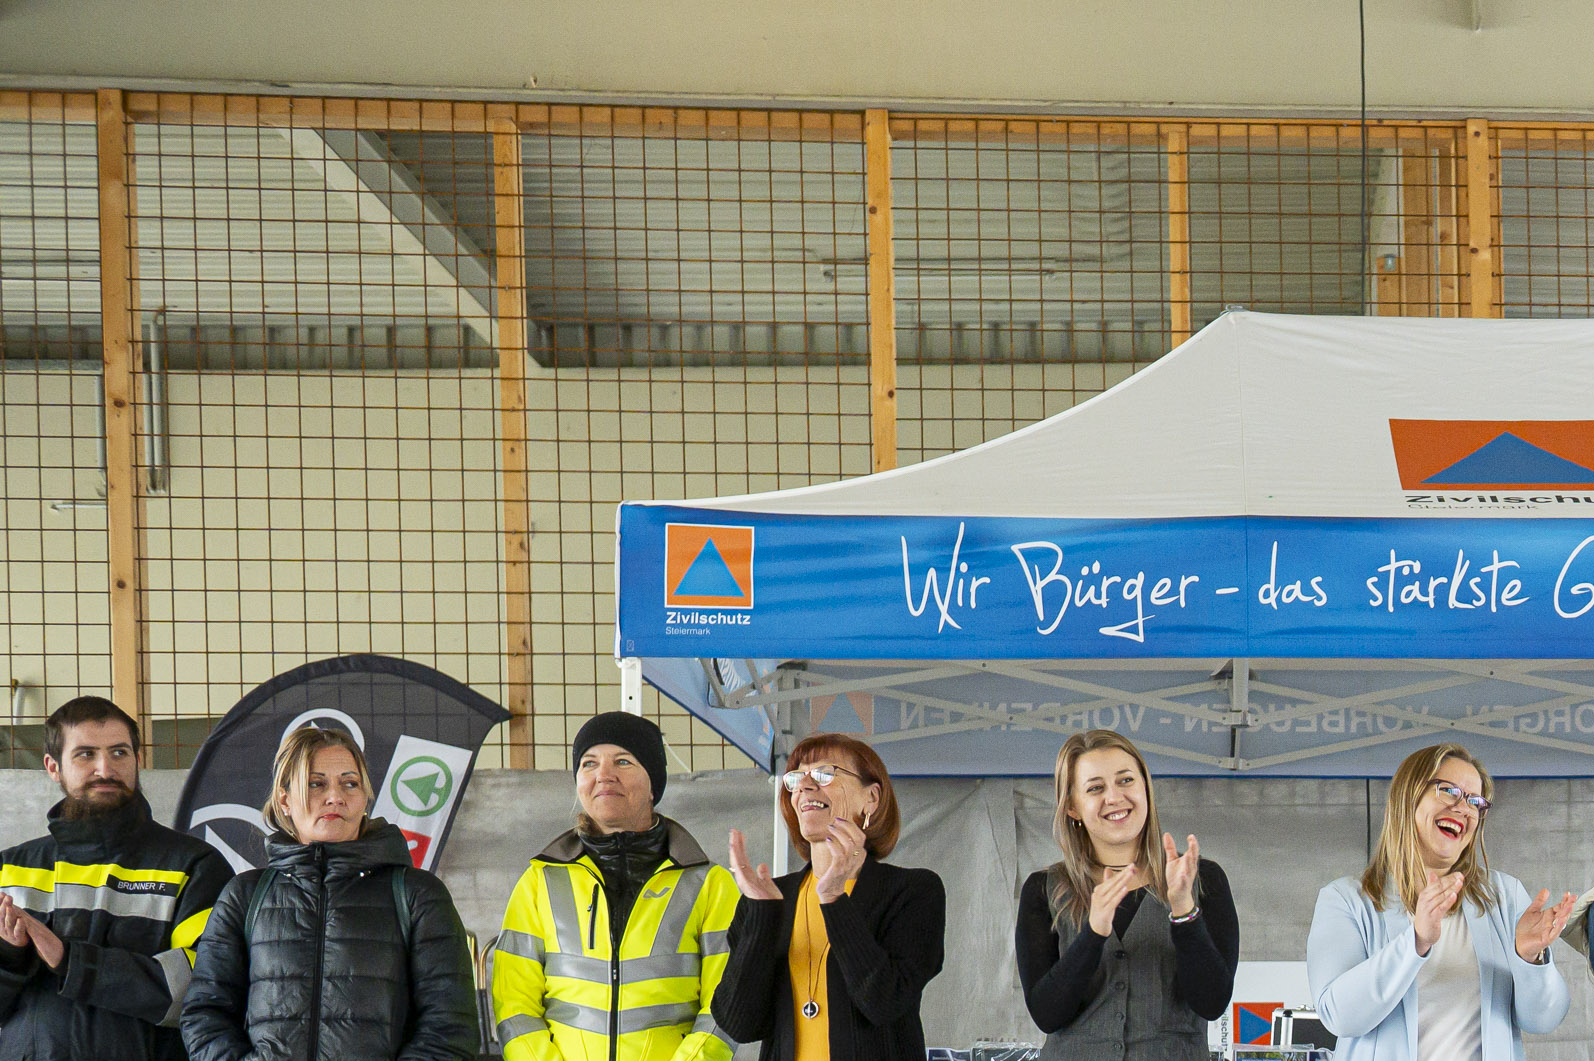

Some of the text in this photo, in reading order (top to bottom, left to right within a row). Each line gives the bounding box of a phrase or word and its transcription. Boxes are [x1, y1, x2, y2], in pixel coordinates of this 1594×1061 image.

[901, 521, 992, 635] Wir
[1010, 540, 1200, 643] Bürger
[1258, 540, 1328, 610] das
[1366, 548, 1529, 614] stärkste
[665, 611, 751, 625] Zivilschutz
[665, 626, 711, 636] Steiermark
[117, 881, 156, 891] BRUNNER
